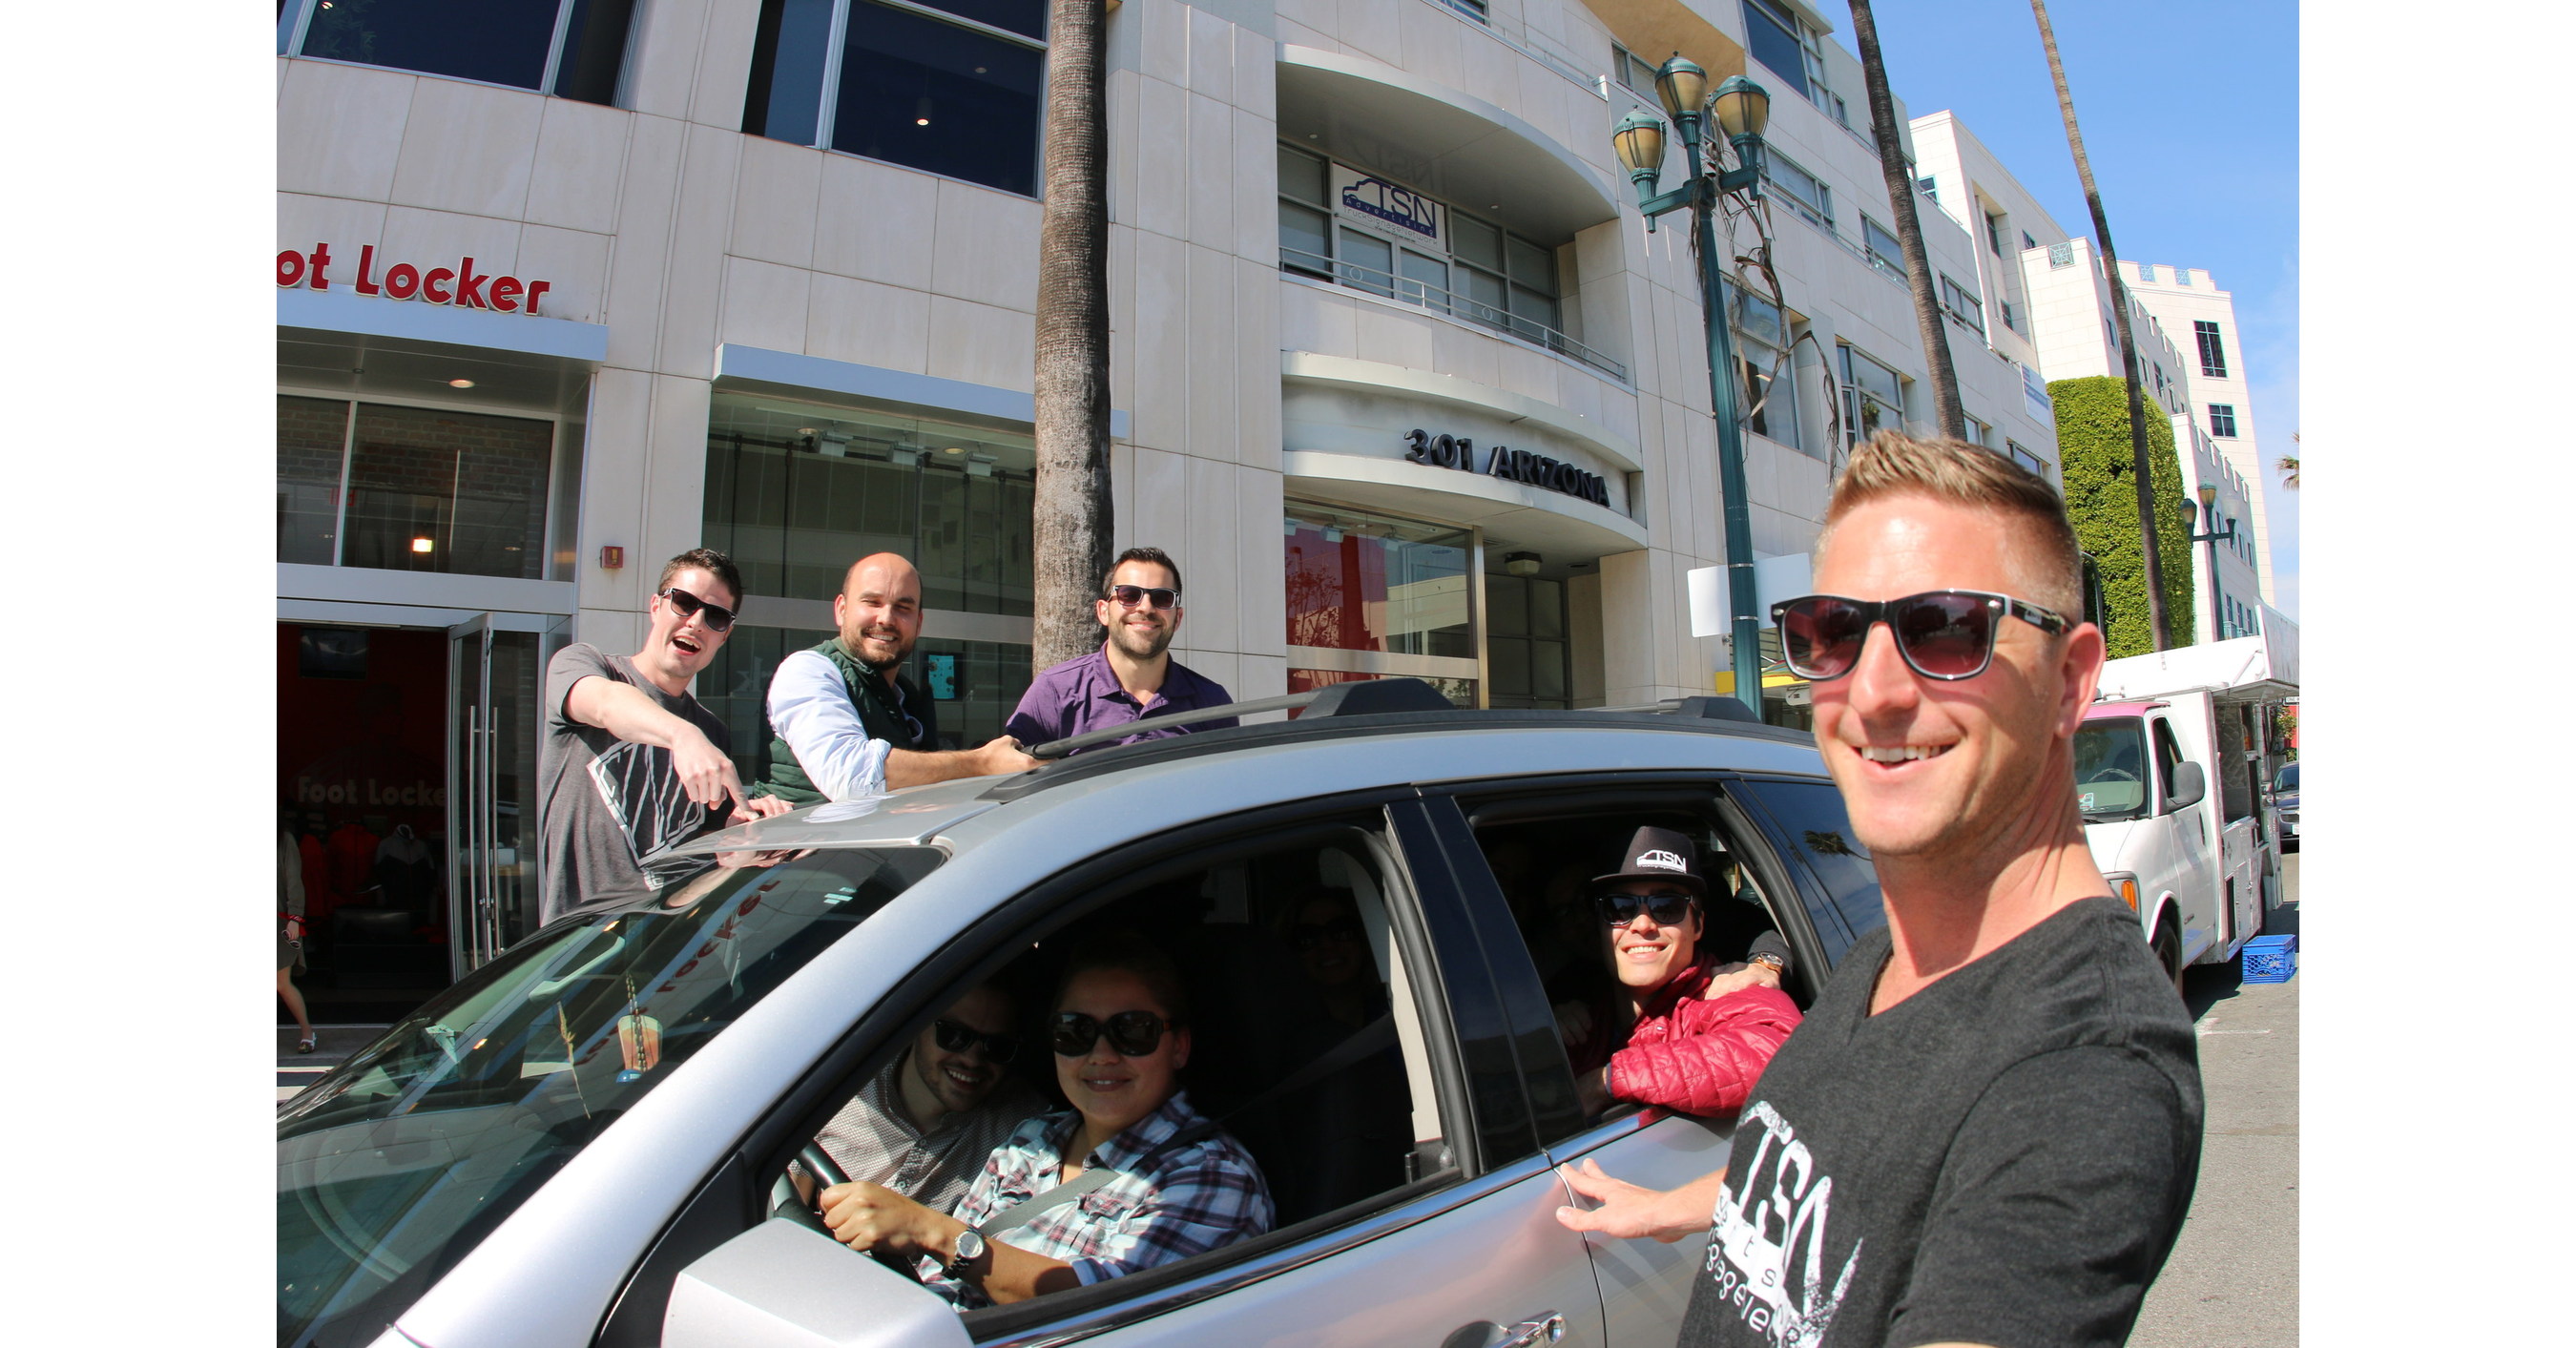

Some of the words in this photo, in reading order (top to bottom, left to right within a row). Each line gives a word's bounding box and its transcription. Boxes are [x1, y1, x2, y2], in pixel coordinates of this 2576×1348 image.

[1345, 197, 1434, 237] Advertising
[1371, 178, 1437, 232] TSN
[354, 243, 551, 316] Locker
[1403, 428, 1474, 472] 301
[1486, 446, 1610, 508] ARIZONA
[298, 776, 358, 804] Foot
[1651, 849, 1687, 871] TSN
